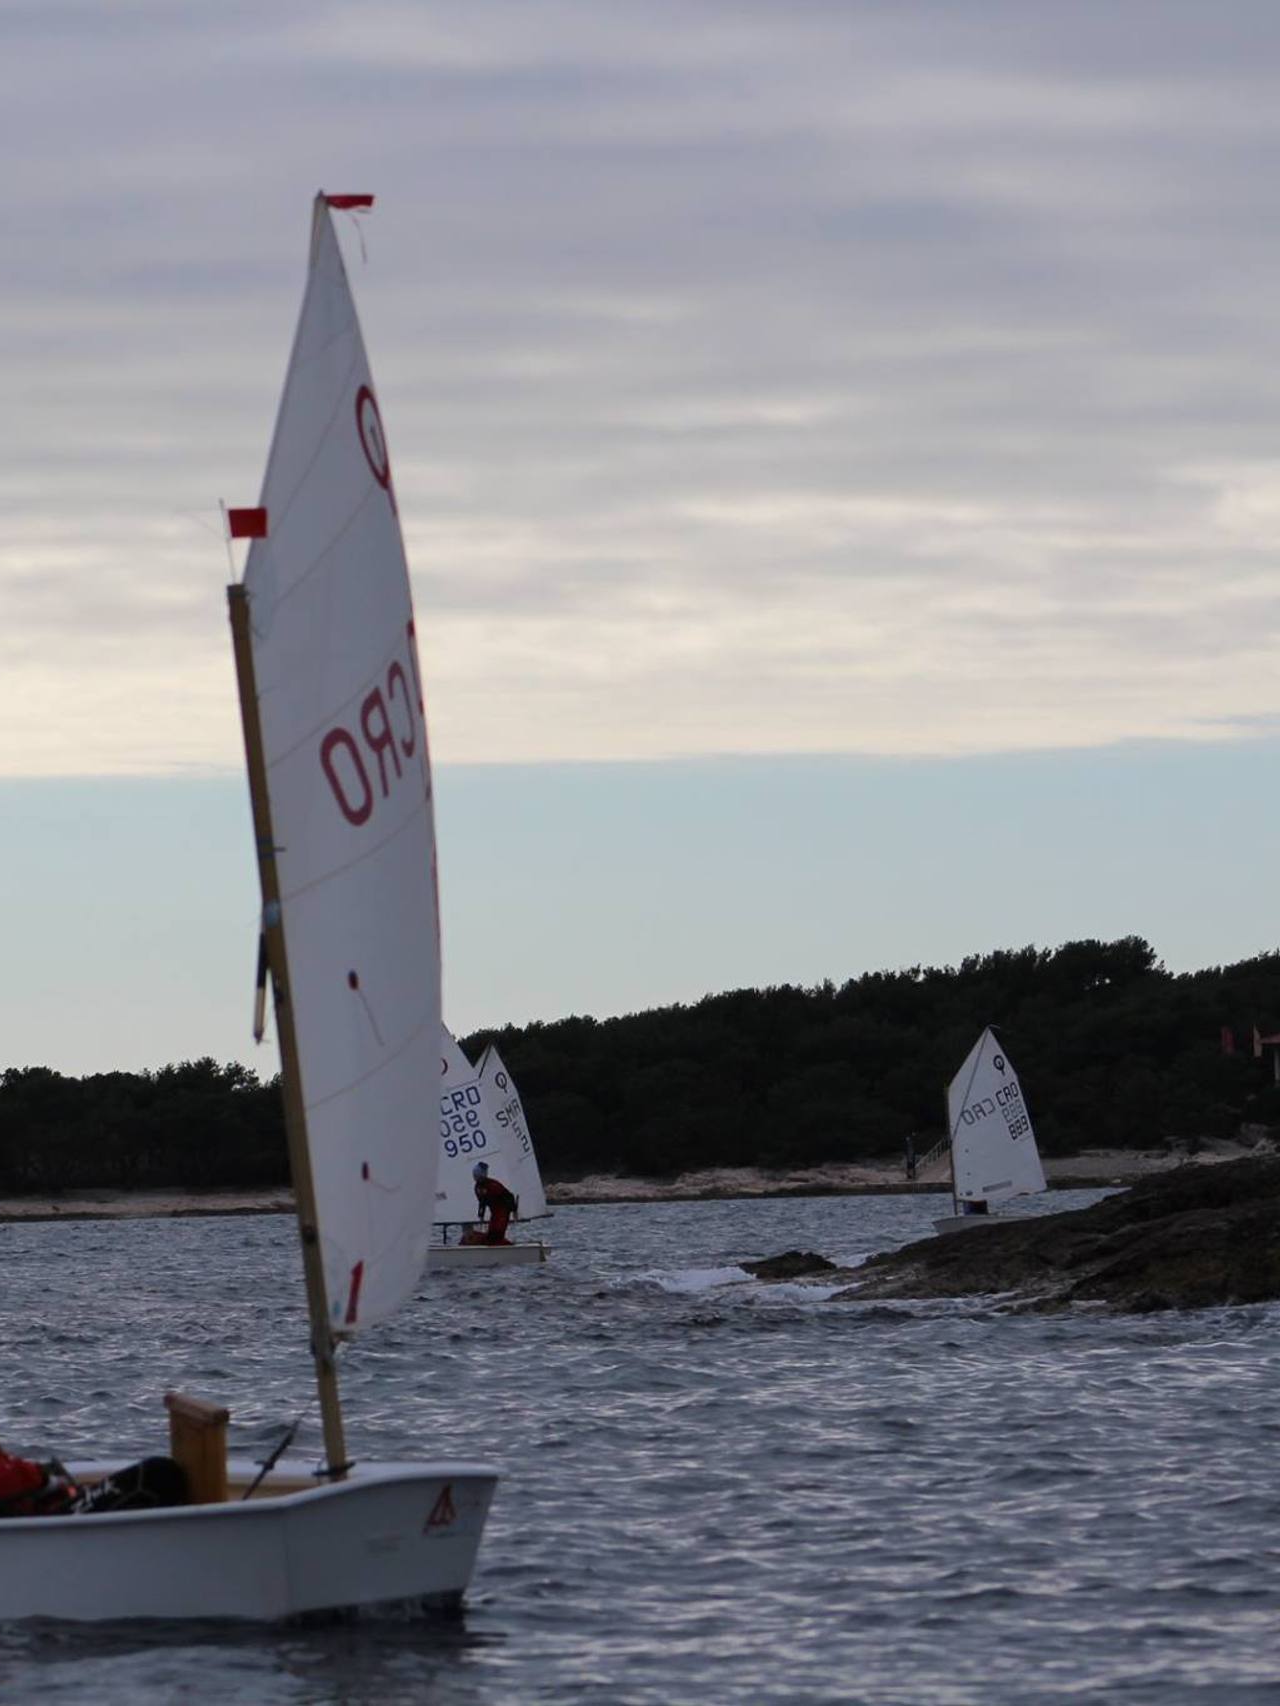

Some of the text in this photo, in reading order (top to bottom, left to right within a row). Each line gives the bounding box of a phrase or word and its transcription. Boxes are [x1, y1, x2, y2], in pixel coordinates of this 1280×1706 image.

[440, 1086, 481, 1116] CRO
[995, 1081, 1019, 1107] CRO
[444, 1129, 487, 1158] 950
